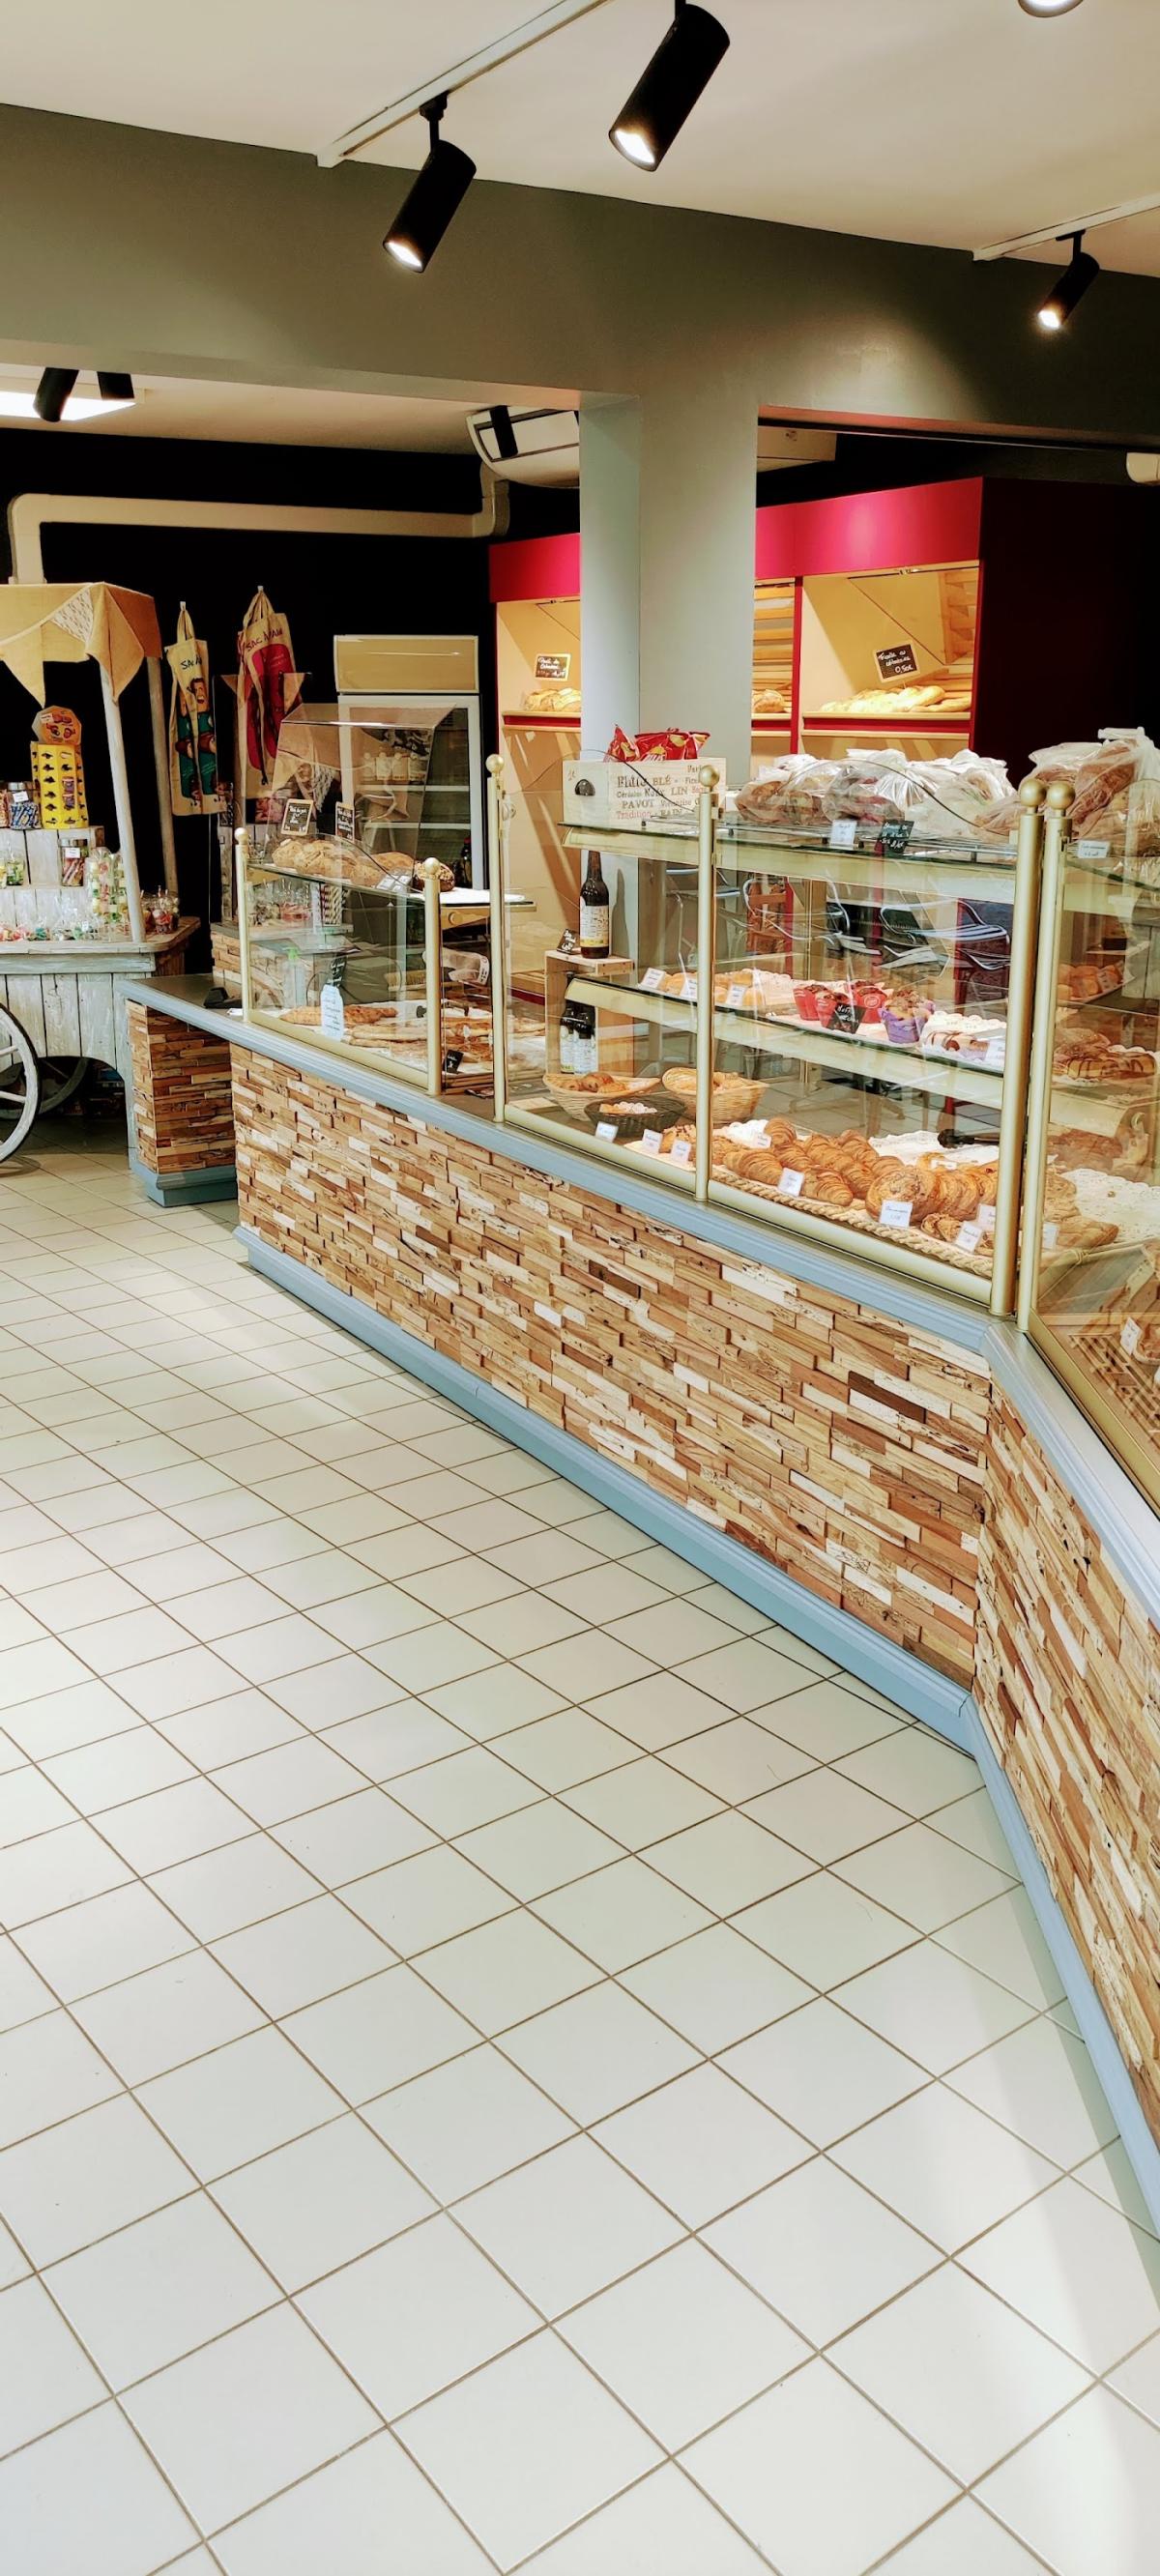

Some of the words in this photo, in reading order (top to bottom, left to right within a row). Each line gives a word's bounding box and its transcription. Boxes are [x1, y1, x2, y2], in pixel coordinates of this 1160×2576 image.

[246, 637, 263, 651] SAC
[652, 774, 671, 786] BLÉ
[671, 787, 688, 796] LIN
[622, 799, 655, 809] PAVOT
